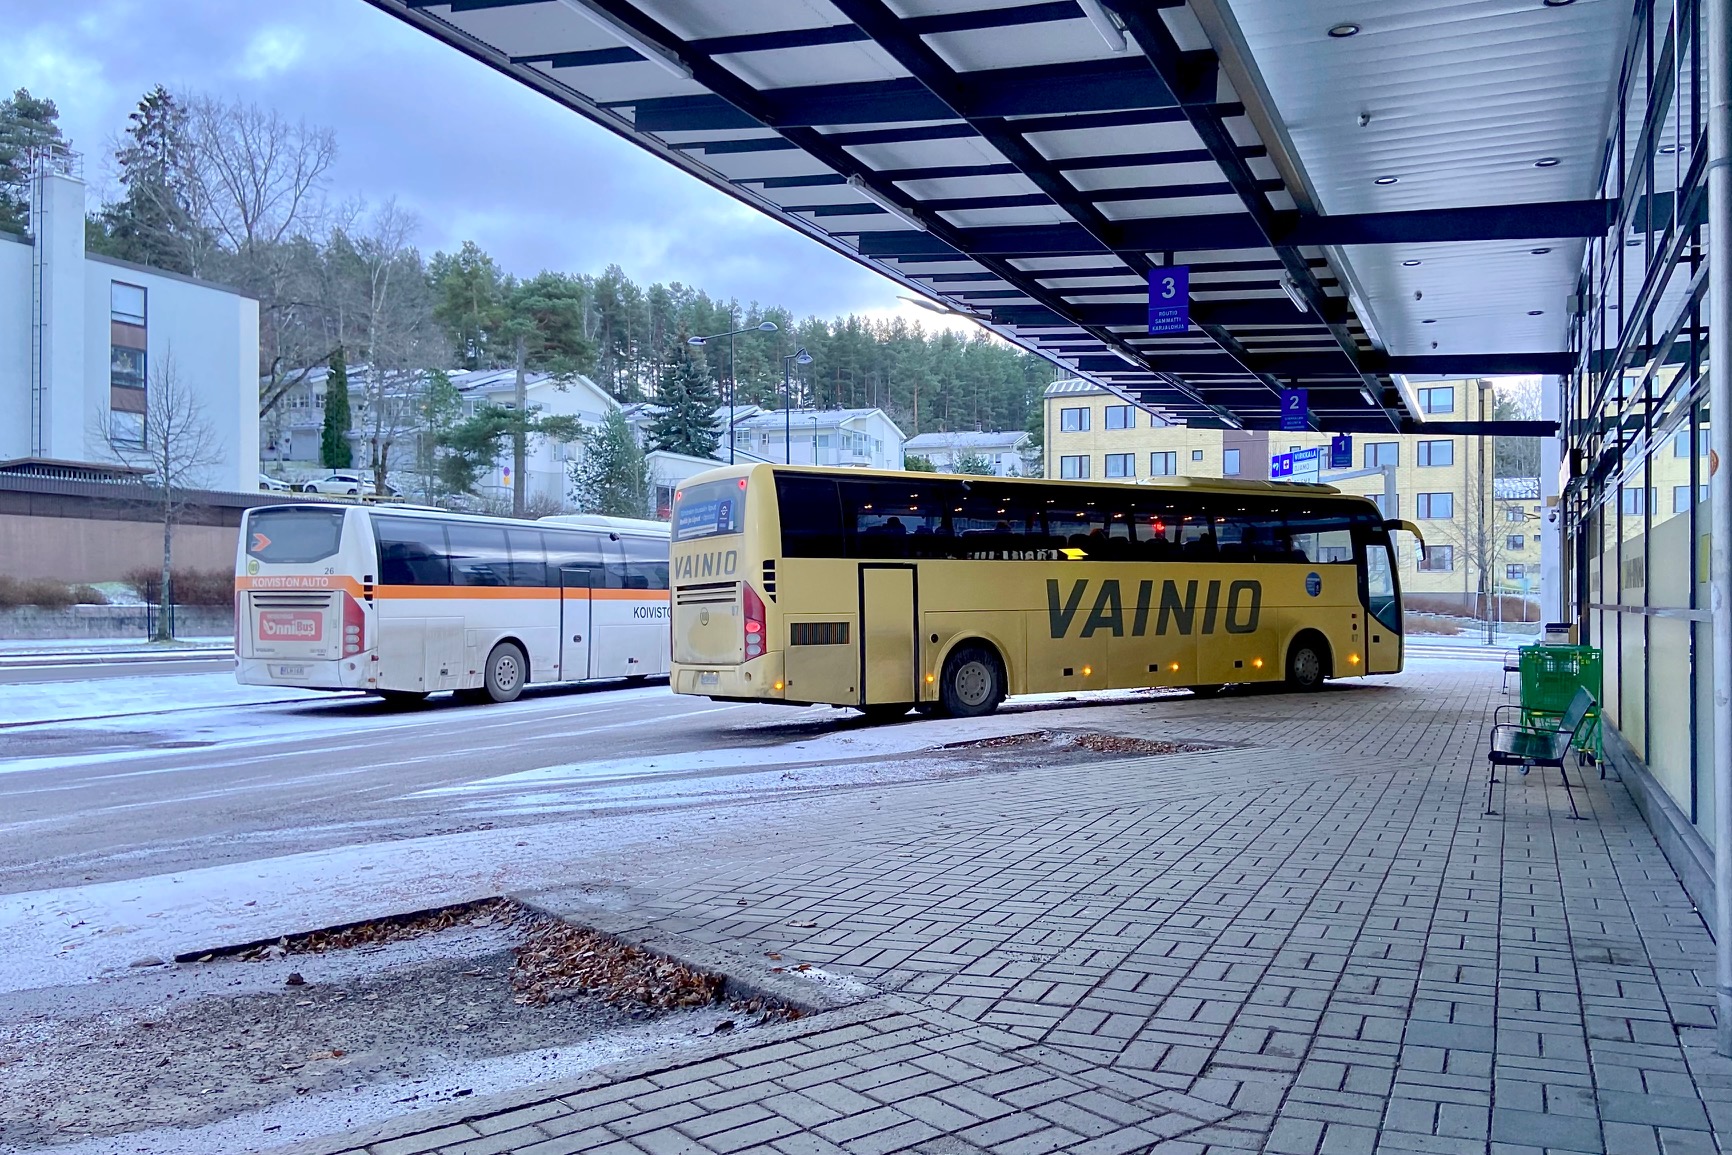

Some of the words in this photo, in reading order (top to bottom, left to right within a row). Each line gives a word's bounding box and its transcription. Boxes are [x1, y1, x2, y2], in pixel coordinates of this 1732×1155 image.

[1161, 276, 1176, 299] 3
[1289, 395, 1299, 410] 2
[1338, 440, 1345, 452] 1
[1294, 449, 1317, 460] VIRKKALA
[324, 567, 335, 575] 26
[674, 550, 738, 580] VAINIO
[252, 577, 300, 588] KOIVISTON
[302, 577, 329, 587] AUTO
[1046, 578, 1262, 639] VAINIO
